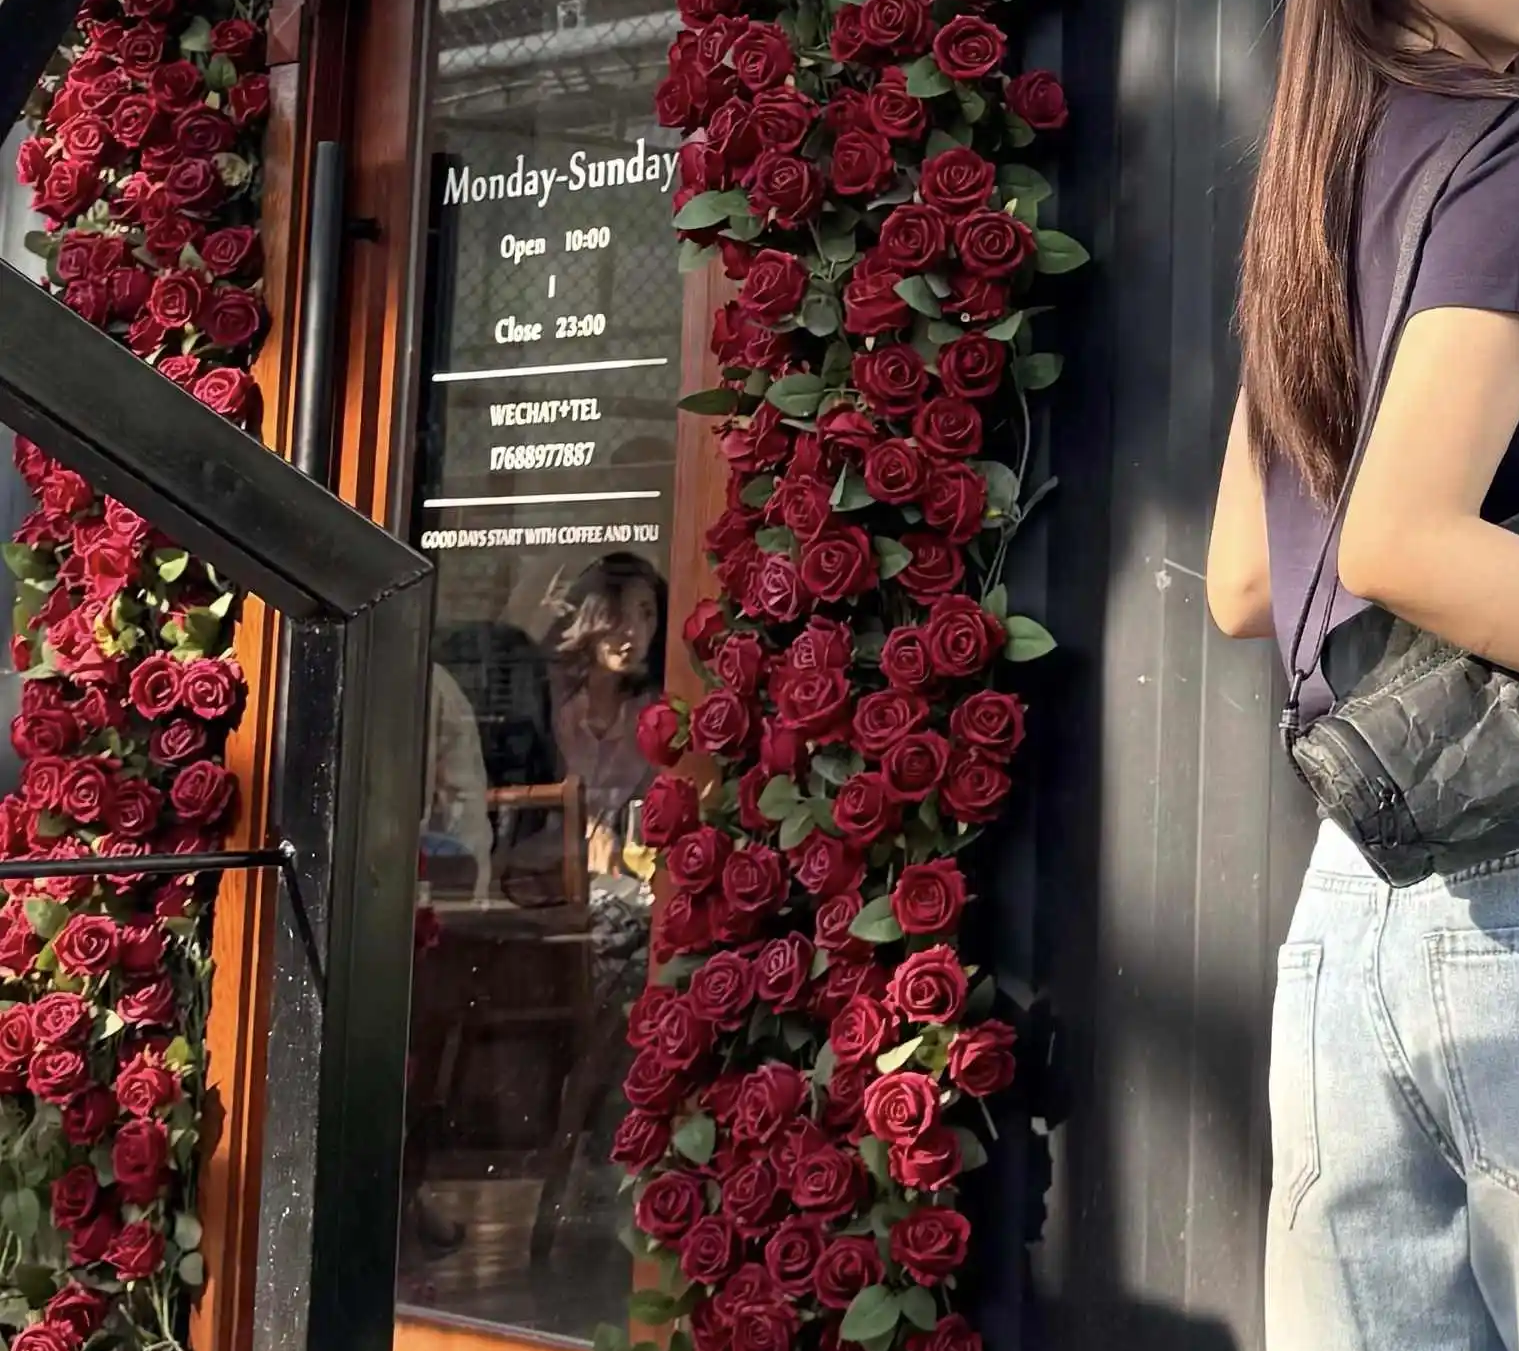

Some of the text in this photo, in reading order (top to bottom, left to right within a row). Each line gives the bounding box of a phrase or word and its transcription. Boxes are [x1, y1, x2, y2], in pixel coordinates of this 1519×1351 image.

[443, 137, 680, 208] Monday-Sunday
[500, 226, 611, 265] Open 10:00
[494, 313, 606, 344] Close 23:00
[489, 397, 602, 427] WECHAT+TEL
[421, 524, 659, 549] GOOD DAYS START WITH COFFEE AND YOU
